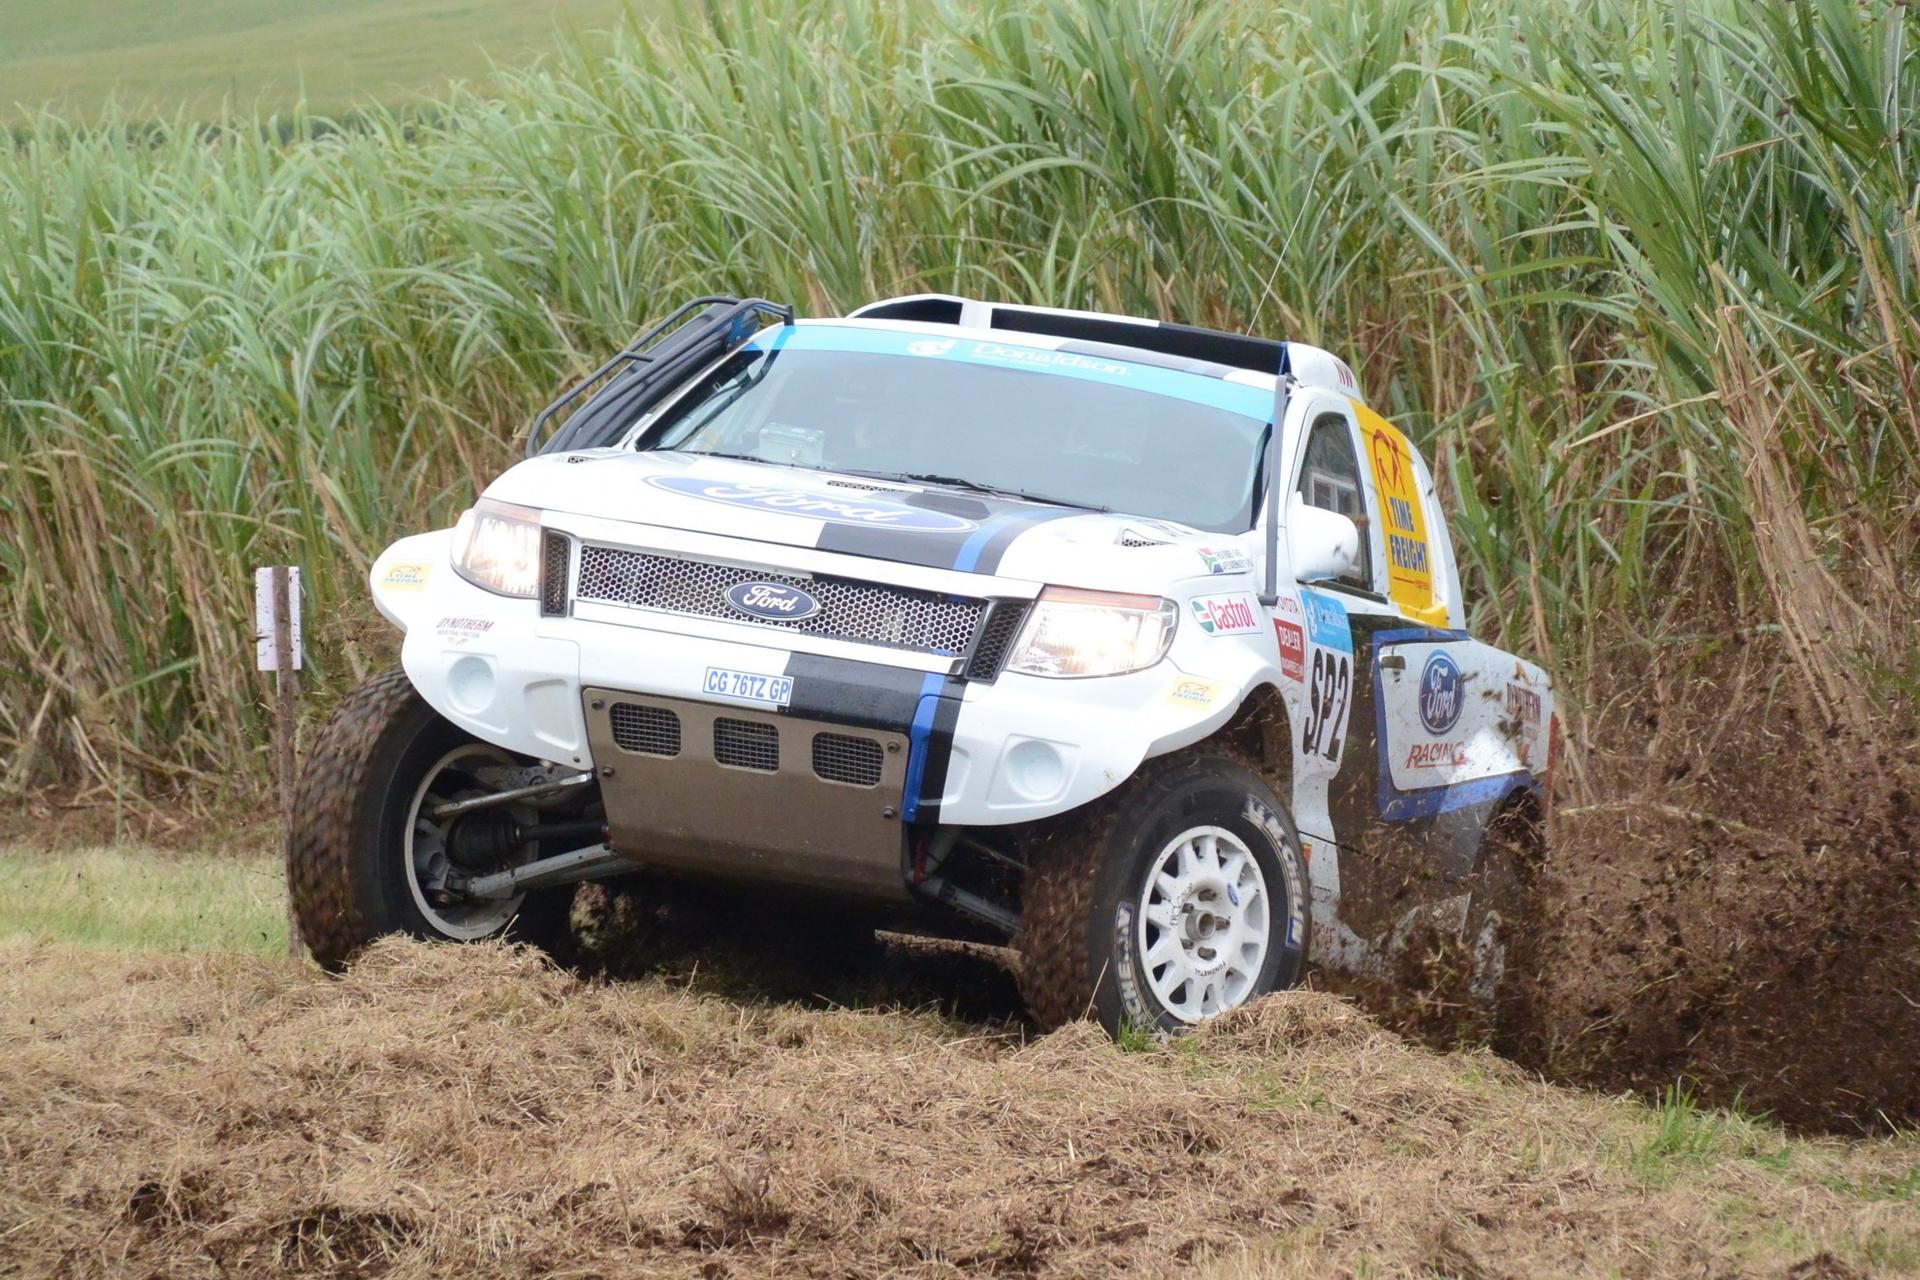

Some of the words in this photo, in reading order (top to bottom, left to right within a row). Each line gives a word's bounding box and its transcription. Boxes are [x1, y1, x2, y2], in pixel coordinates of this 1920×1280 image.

[969, 342, 1129, 376] Donaldson
[704, 483, 916, 522] Ford
[1389, 496, 1415, 532] TIME
[1389, 534, 1429, 574] FREIGHT
[742, 586, 800, 613] Ford
[1207, 598, 1256, 631] Castrol
[708, 671, 729, 693] CG
[732, 674, 768, 698] 76TZ
[769, 679, 790, 700] GP
[1426, 665, 1457, 720] Ford
[1303, 648, 1349, 763] SP2
[1406, 741, 1468, 768] RACING
